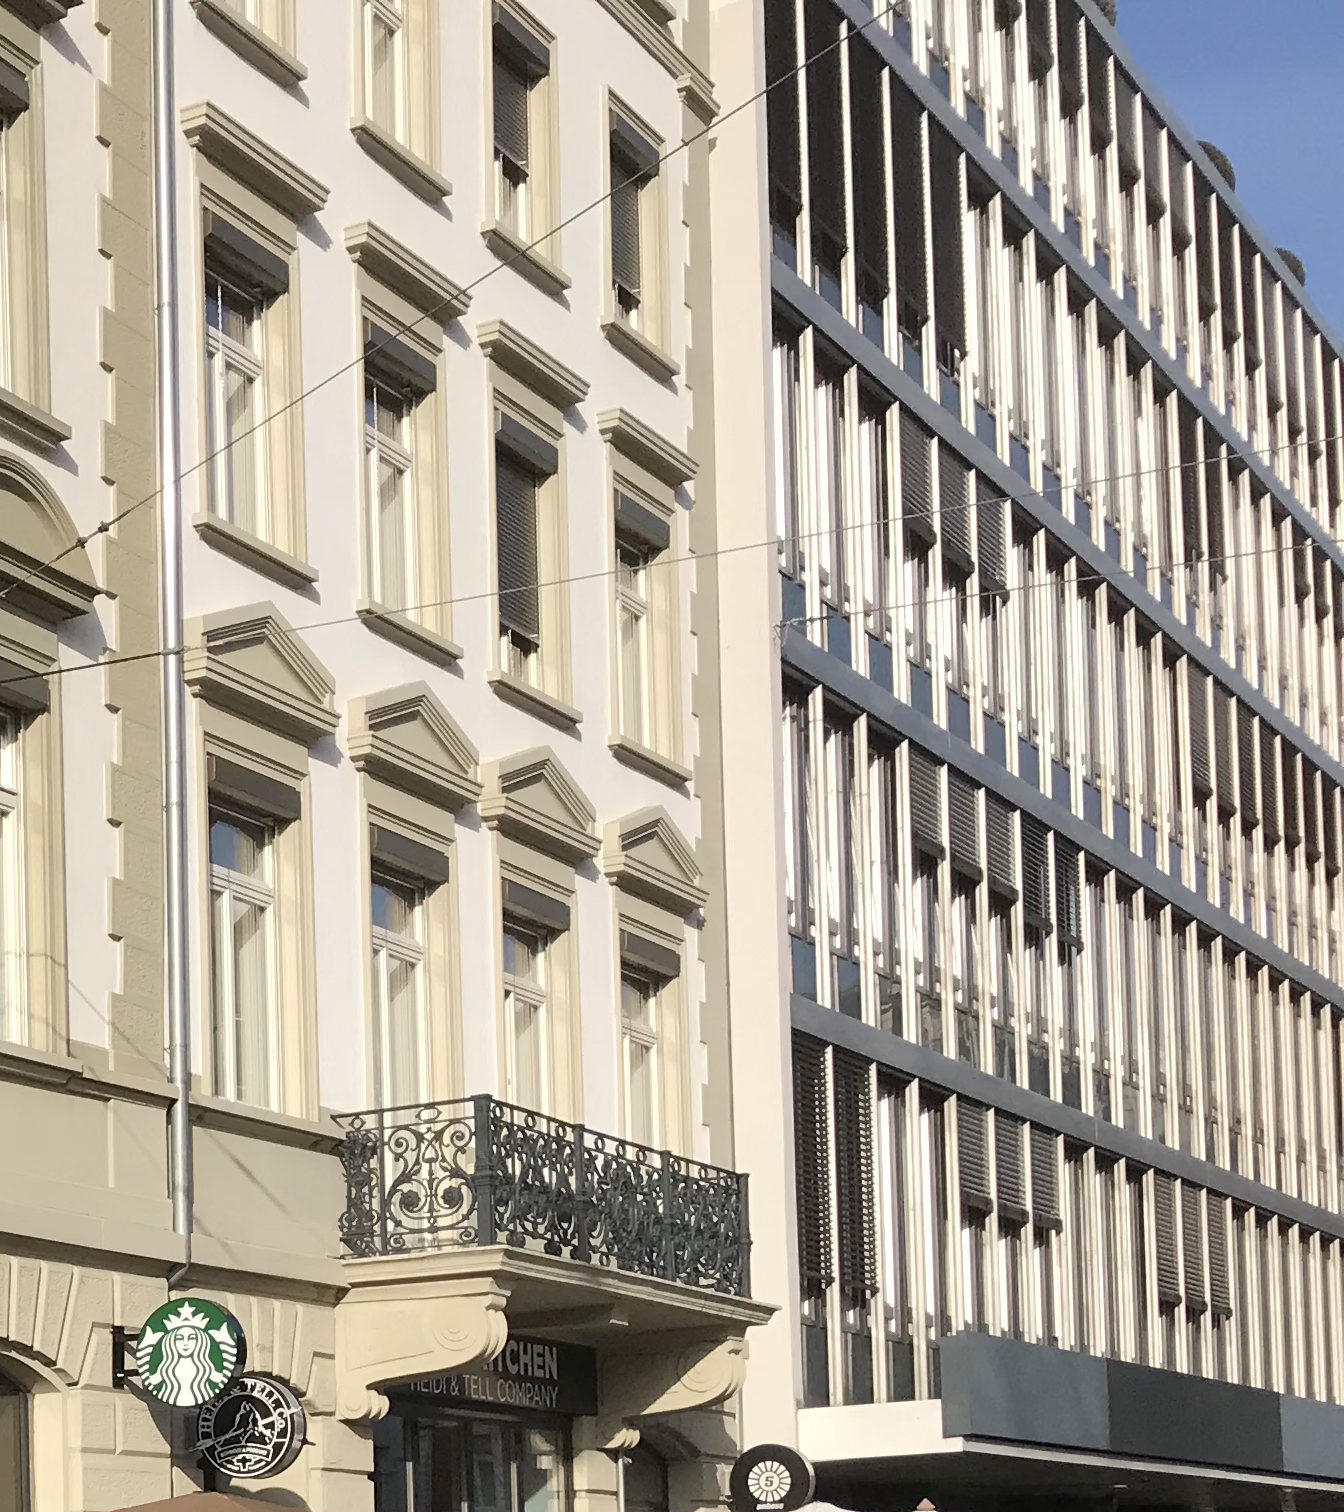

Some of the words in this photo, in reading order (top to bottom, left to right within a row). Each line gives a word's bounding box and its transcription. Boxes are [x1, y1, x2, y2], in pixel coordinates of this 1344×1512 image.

[482, 1340, 559, 1380] TCHEN
[244, 1380, 280, 1408] TELL
[462, 1374, 494, 1400] TELL
[497, 1378, 559, 1408] COMPANY
[764, 1475, 775, 1488] 5
